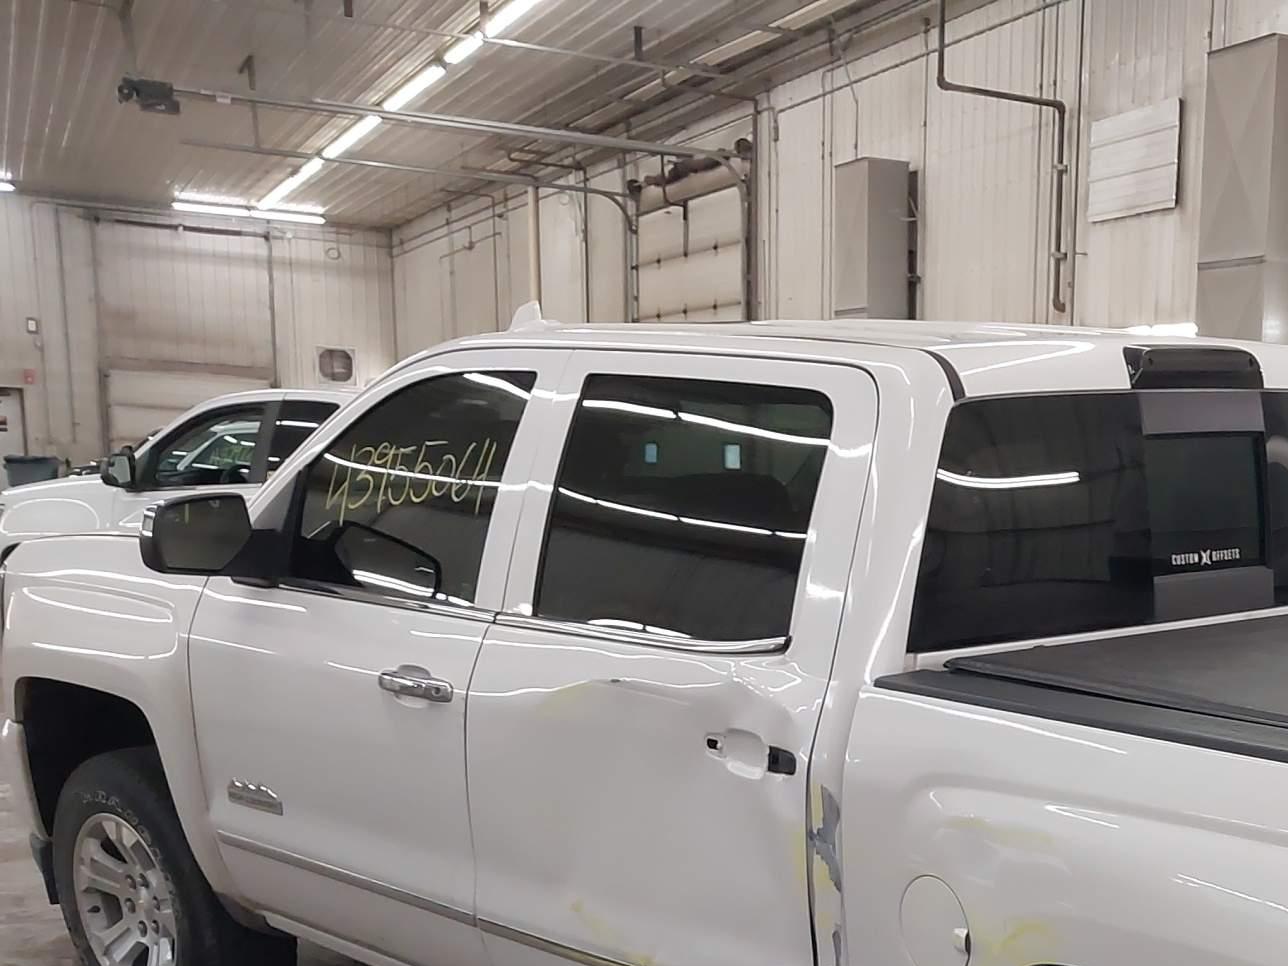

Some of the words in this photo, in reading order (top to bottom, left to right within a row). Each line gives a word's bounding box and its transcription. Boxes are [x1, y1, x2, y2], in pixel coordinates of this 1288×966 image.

[325, 437, 497, 526] 43955064
[1171, 553, 1199, 566] CUSTOM
[1211, 547, 1240, 562] OFFSETS
